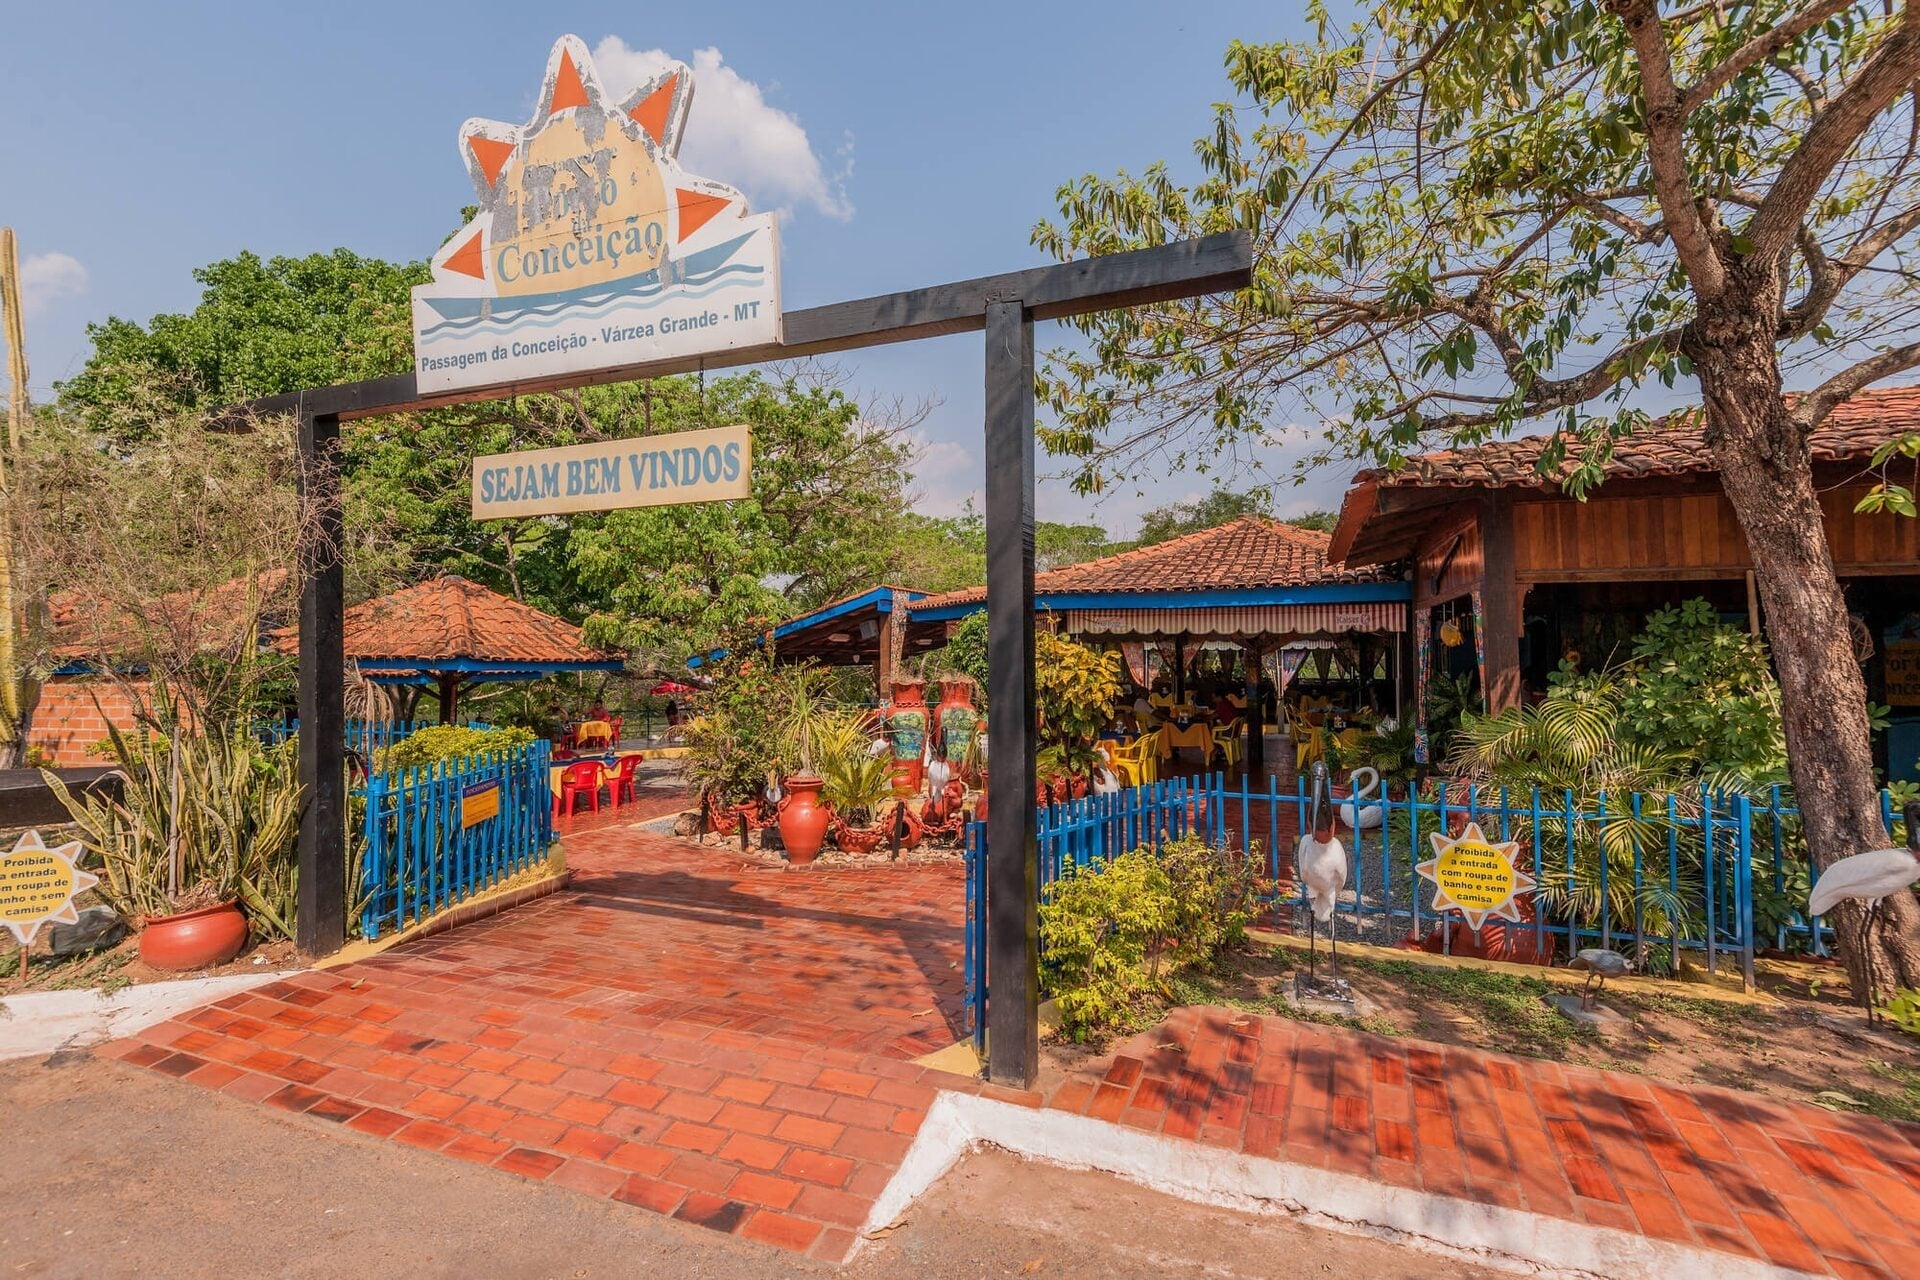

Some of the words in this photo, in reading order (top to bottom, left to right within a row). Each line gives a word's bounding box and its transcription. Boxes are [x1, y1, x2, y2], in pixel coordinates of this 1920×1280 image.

[497, 214, 663, 283] Conceição
[421, 350, 487, 372] Passagem
[491, 345, 508, 361] da
[512, 333, 587, 357] Conceição
[601, 325, 655, 344] Várzea
[659, 311, 718, 335] Grande
[734, 301, 760, 322] MT
[481, 462, 560, 504] SEJAM
[566, 455, 622, 496] BEM
[628, 442, 740, 491] VINDOS
[1454, 847, 1495, 858] Proibida
[4, 857, 53, 867] Proibida
[1460, 860, 1498, 869] entrada
[11, 869, 57, 879] entrada
[1441, 869, 1462, 877] com
[1465, 872, 1493, 881] roupa
[1496, 874, 1508, 883] de
[16, 882, 50, 891] roupa
[54, 879, 68, 887] de
[1443, 880, 1473, 890] banho
[1485, 885, 1506, 893] sem
[1456, 893, 1492, 903] camisa
[5, 906, 49, 916] camisa
